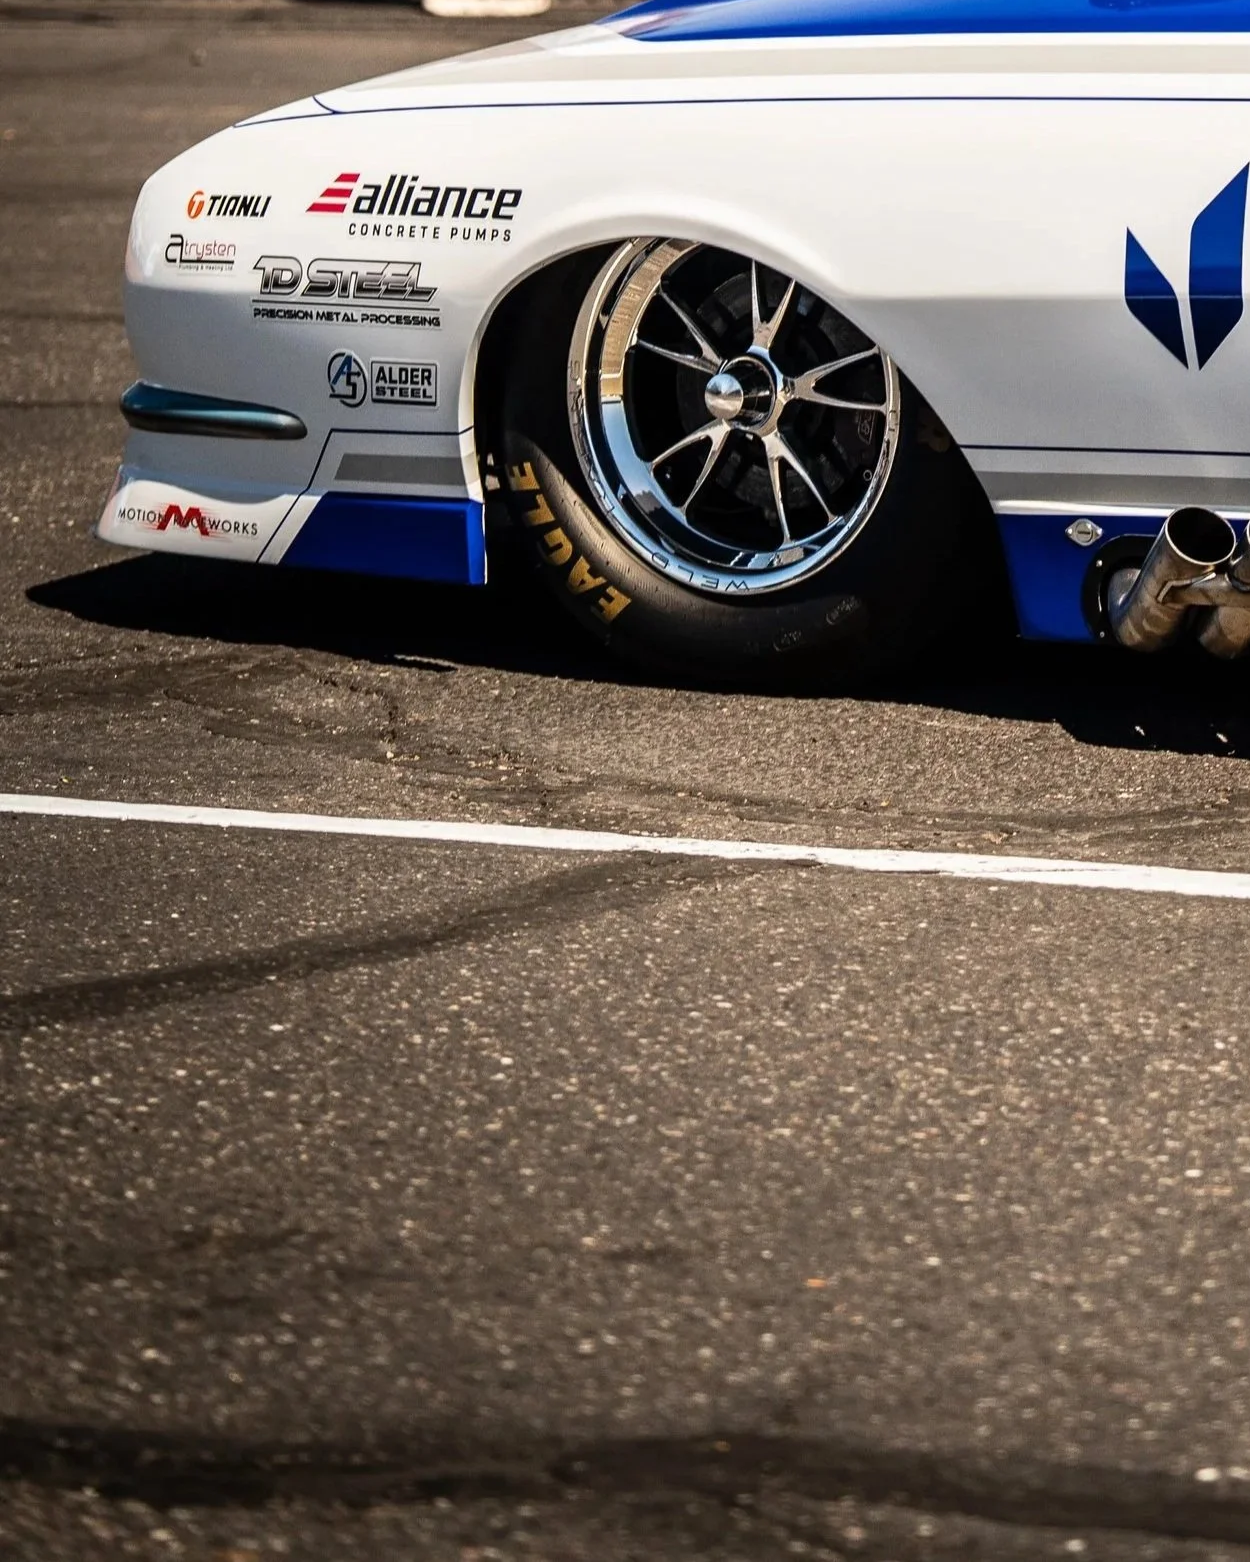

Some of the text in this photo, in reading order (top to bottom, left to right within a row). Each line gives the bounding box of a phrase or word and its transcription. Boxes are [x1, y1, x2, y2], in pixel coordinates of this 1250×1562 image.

[207, 195, 272, 217] TIANLI
[352, 174, 522, 220] alliance
[348, 223, 512, 241] CONCRETE PUMPS
[253, 255, 438, 302] TD STEEL
[253, 308, 441, 327] PRECISION METAL PROCESSING
[375, 366, 433, 386] ALDER
[375, 386, 433, 399] STEEL
[505, 460, 633, 625] EAGLE
[651, 550, 750, 593] WELD
